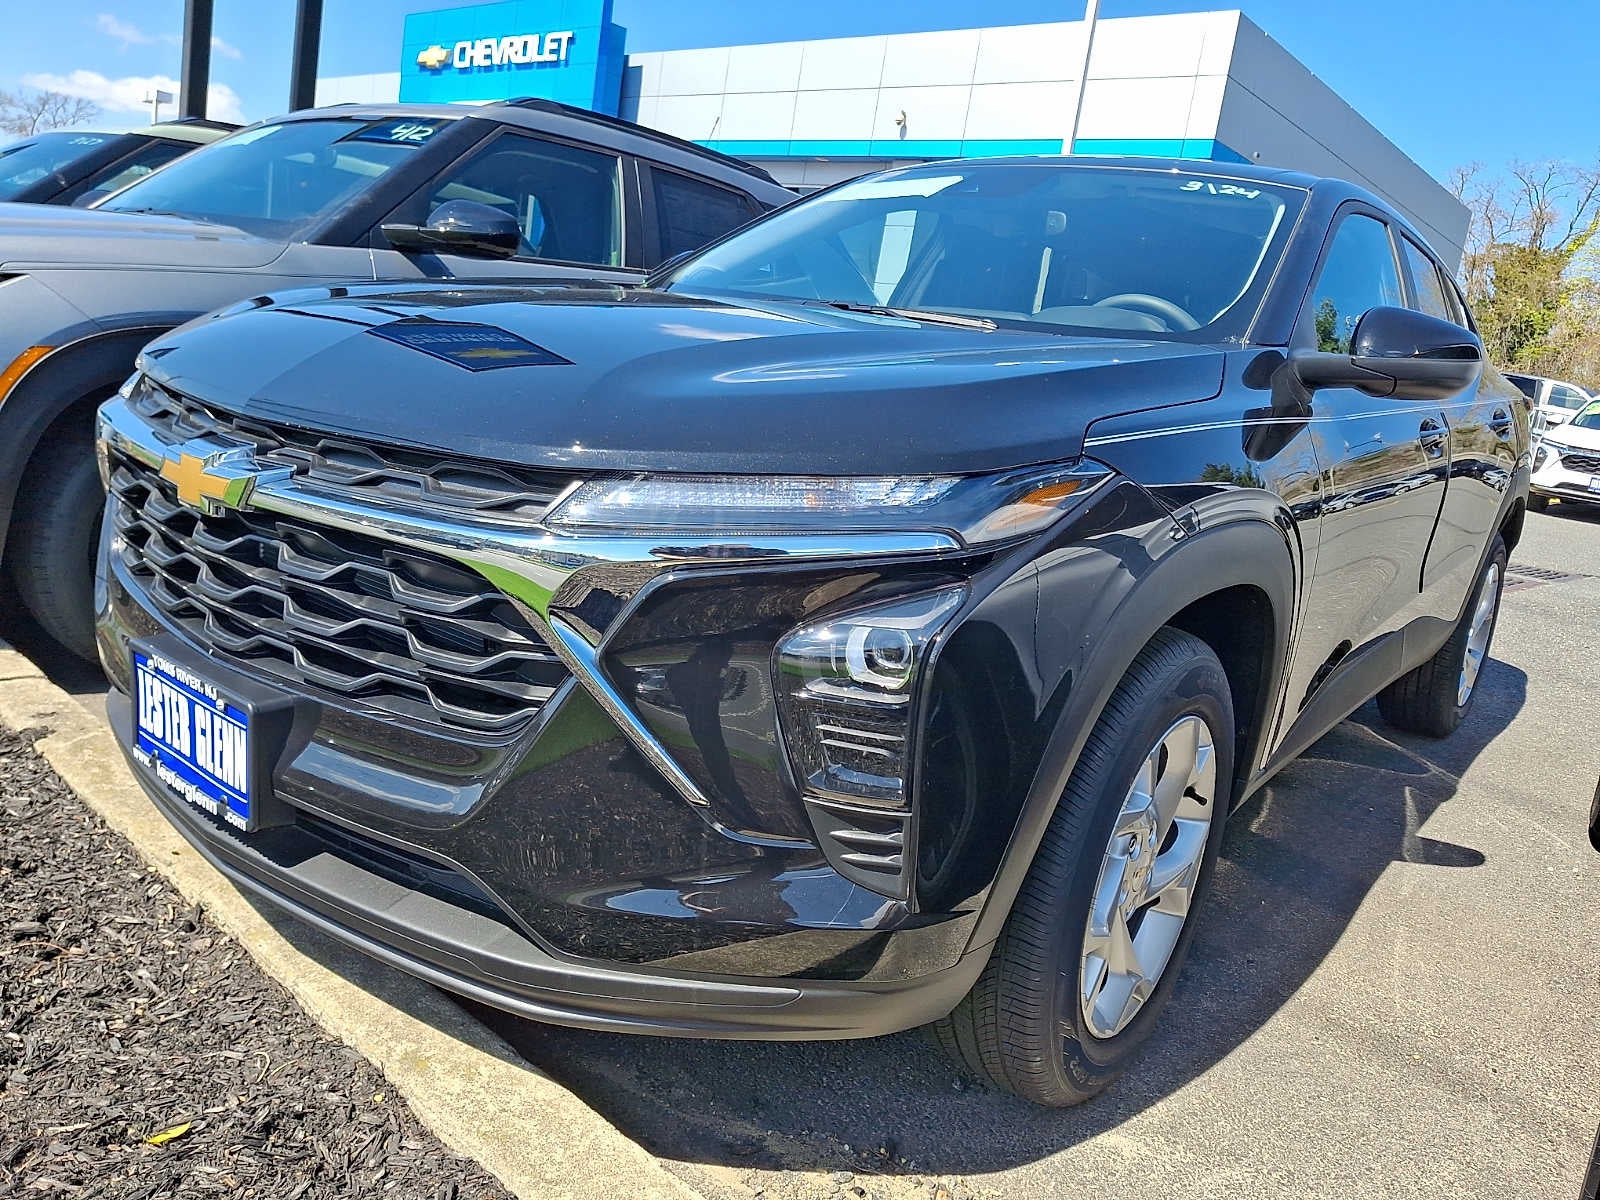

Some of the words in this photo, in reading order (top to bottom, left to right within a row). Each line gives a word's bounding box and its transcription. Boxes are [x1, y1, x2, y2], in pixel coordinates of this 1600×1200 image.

[453, 31, 573, 69] CHEVROLET
[152, 654, 177, 679] TOMS
[204, 682, 218, 700] NJ
[137, 668, 192, 758] LESTER
[194, 704, 248, 795] GLENN
